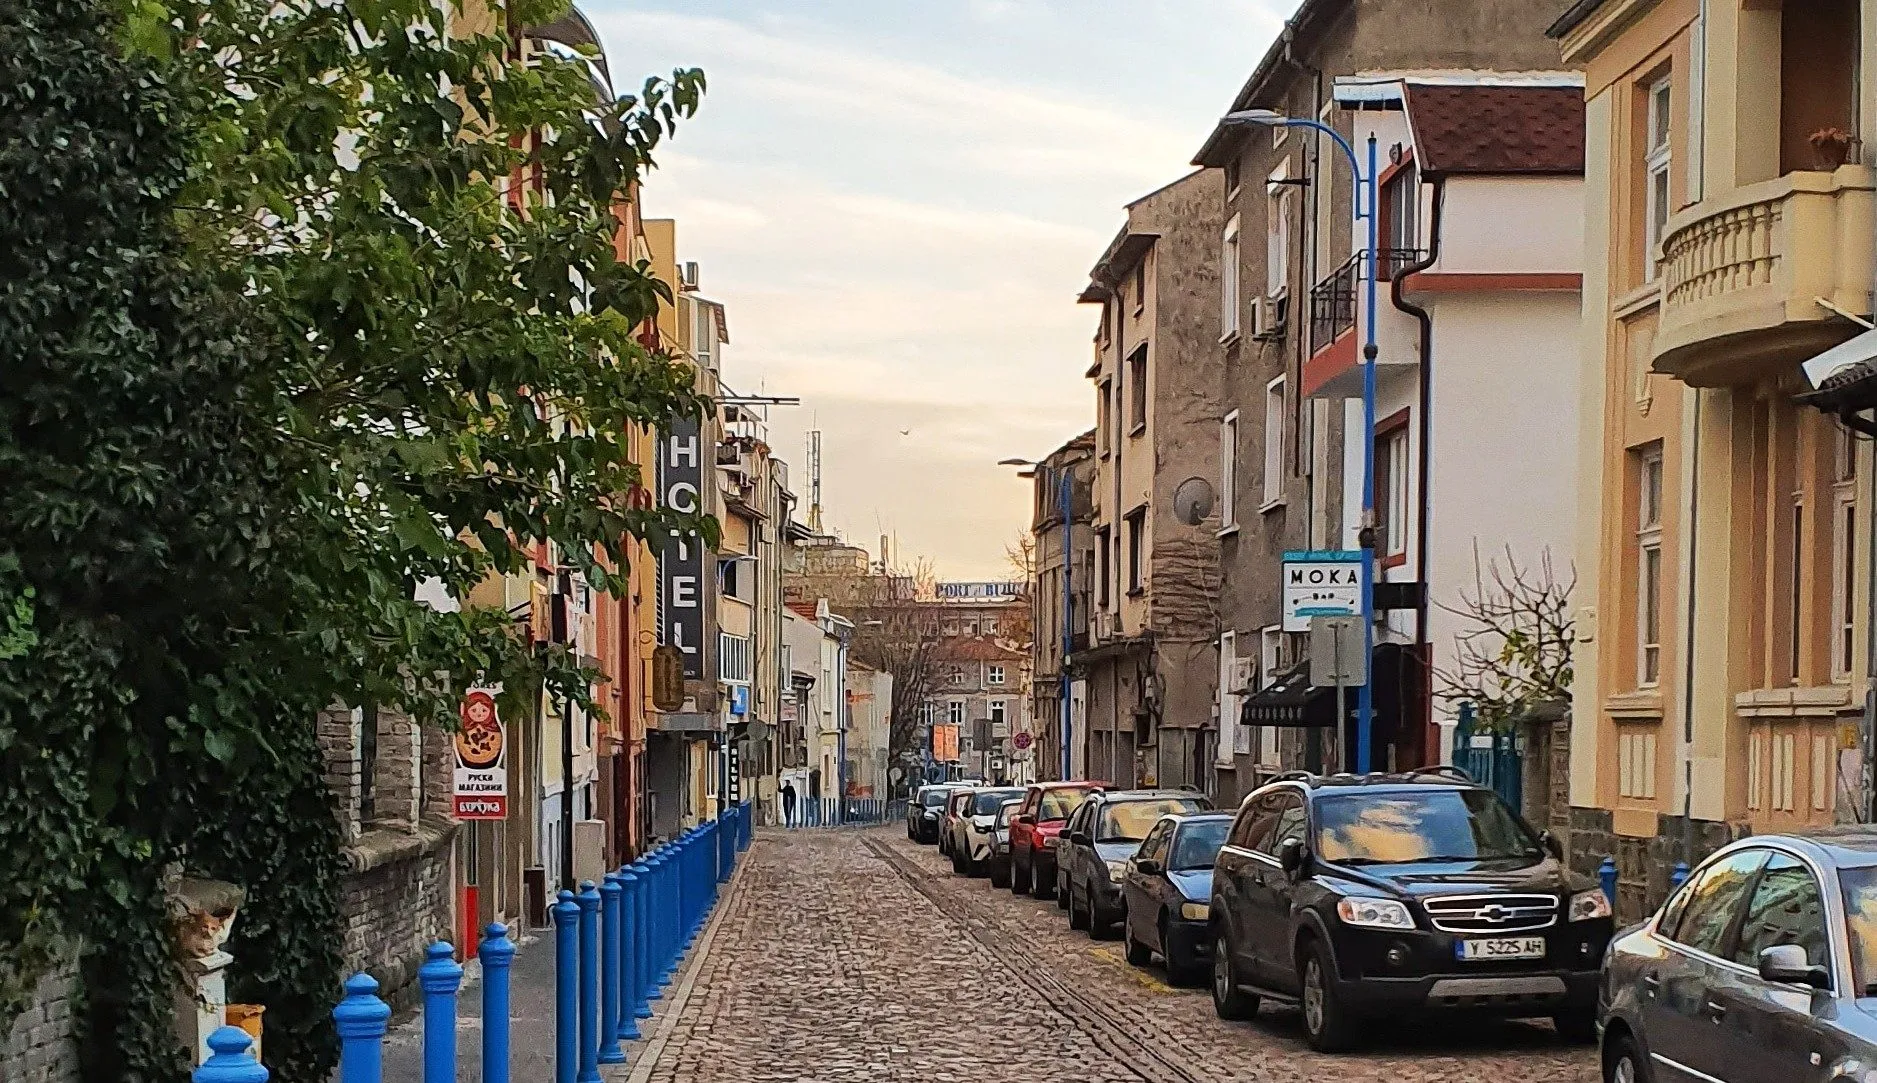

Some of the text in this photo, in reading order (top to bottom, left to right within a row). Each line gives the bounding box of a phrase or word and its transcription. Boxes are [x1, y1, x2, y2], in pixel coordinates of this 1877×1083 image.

[668, 435, 698, 654] HOTEL
[1291, 569, 1358, 584] MOKA
[1486, 941, 1521, 955] 5225
